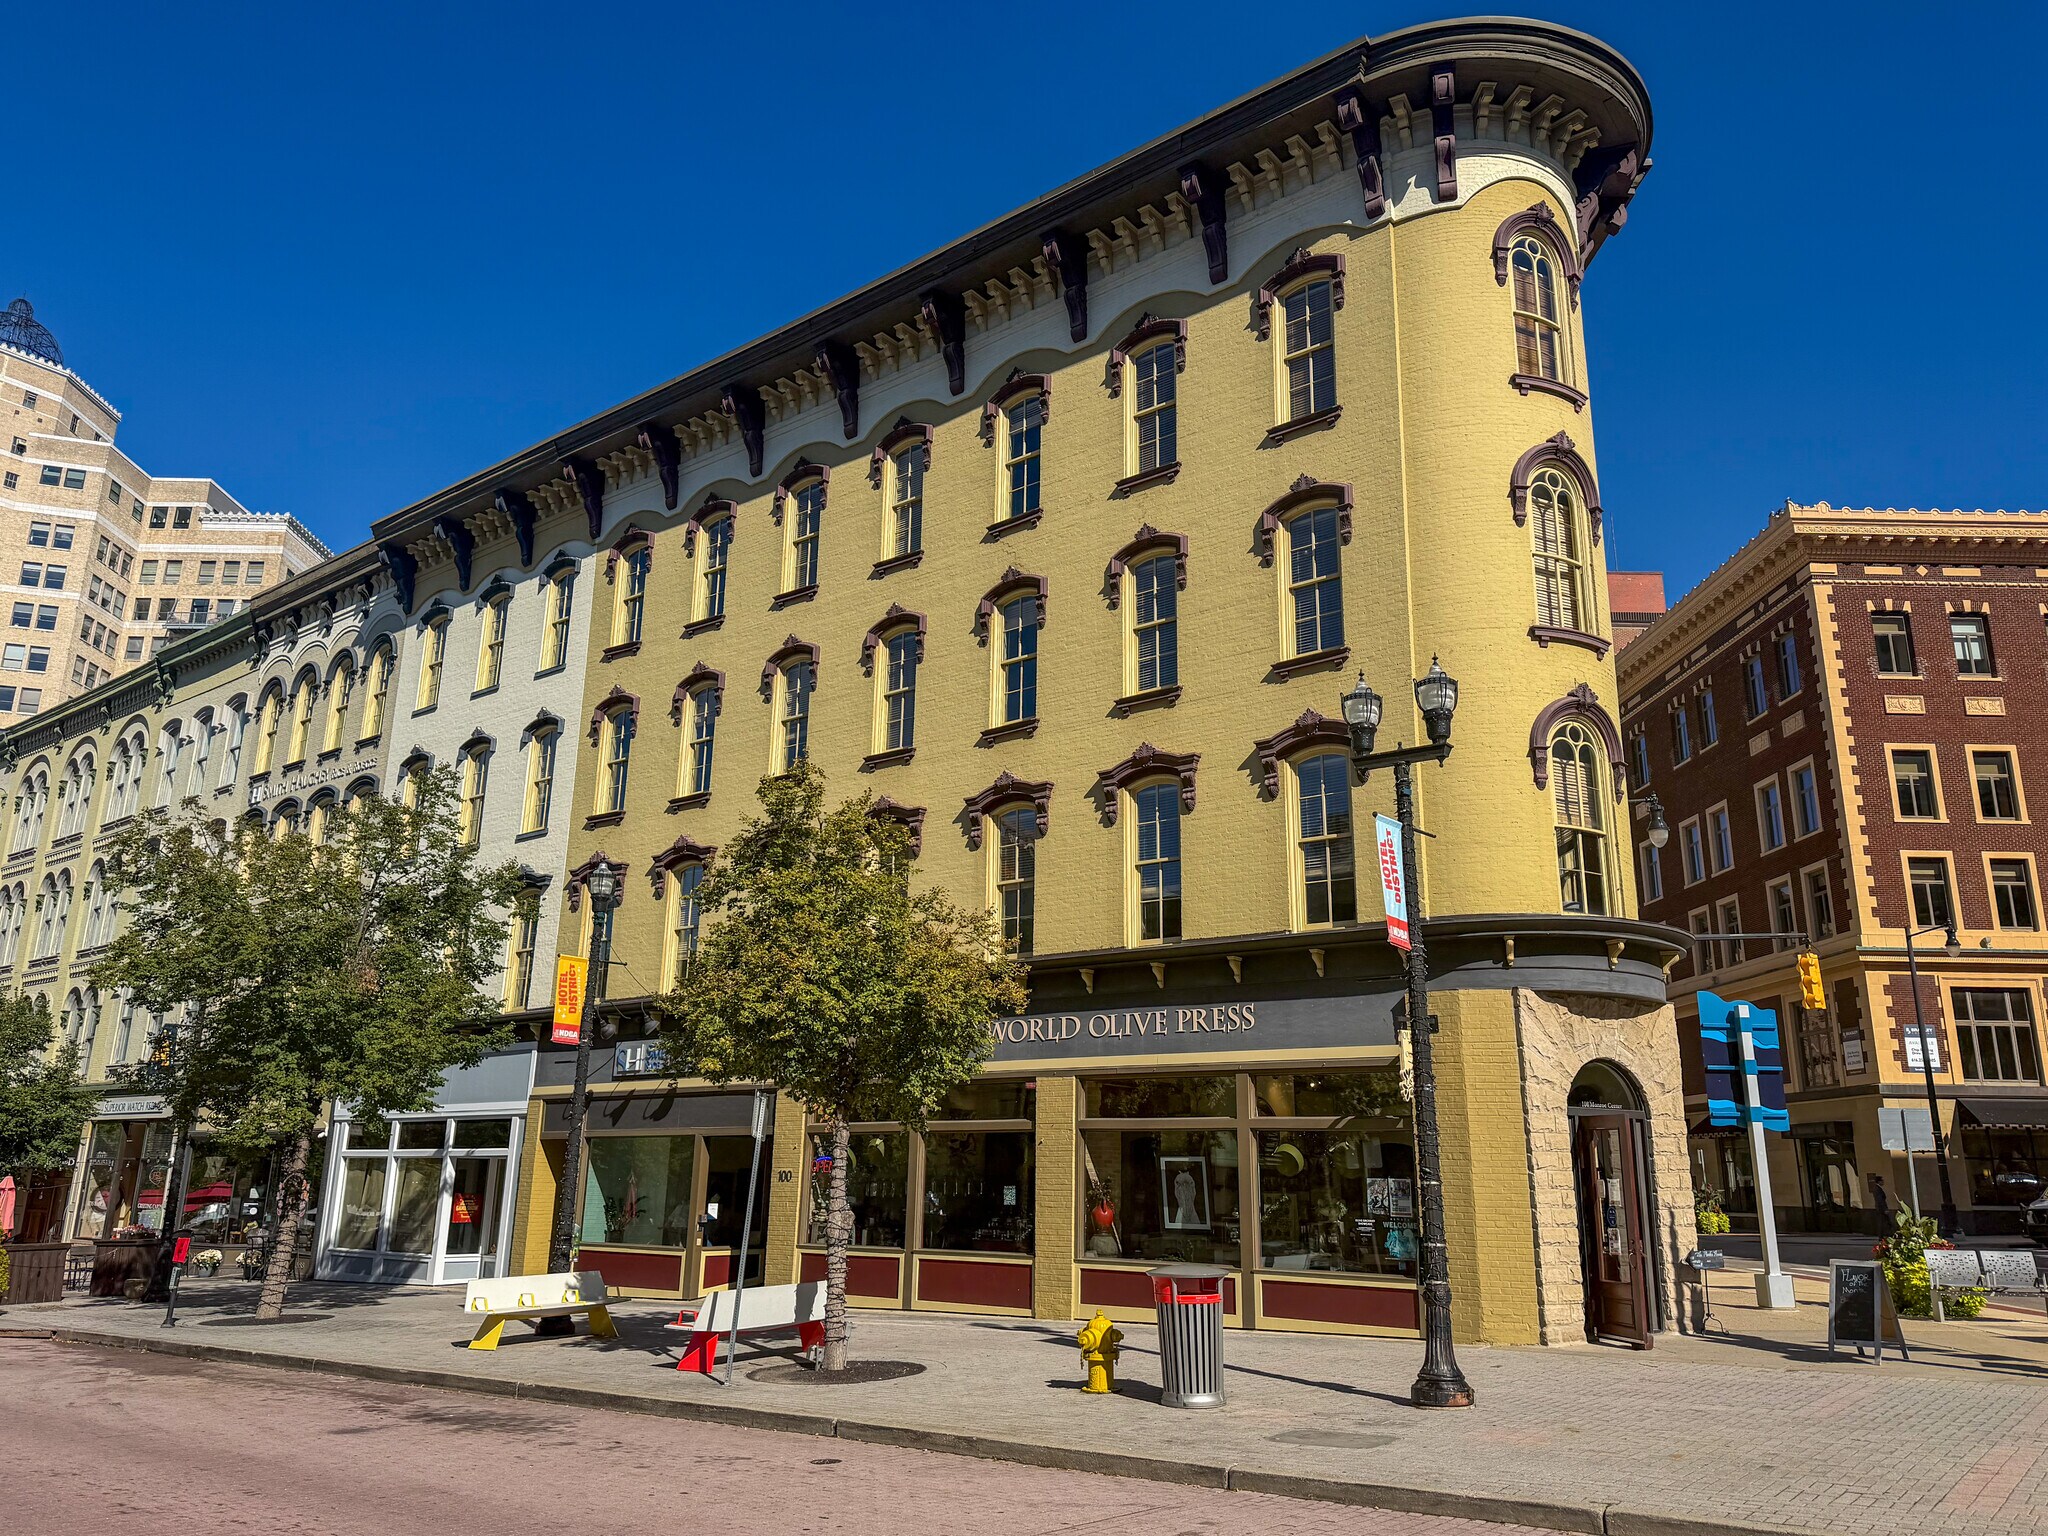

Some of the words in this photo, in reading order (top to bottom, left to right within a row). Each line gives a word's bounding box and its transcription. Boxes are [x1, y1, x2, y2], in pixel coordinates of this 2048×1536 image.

[262, 780, 289, 801] SMITH
[1380, 838, 1394, 891] HOTEL
[1386, 828, 1402, 904] DISTRICT
[558, 971, 568, 1006] HOTEL
[568, 963, 577, 1014] DISTRICT
[990, 1015, 1081, 1044] WORLD
[1088, 1008, 1168, 1039] OLIVE
[1175, 1002, 1256, 1034] PRESS
[104, 1101, 126, 1113] SUPERIOR
[126, 1100, 145, 1111] WATCH
[777, 1170, 793, 1183] 100
[1382, 1221, 1418, 1229] WELCOME
